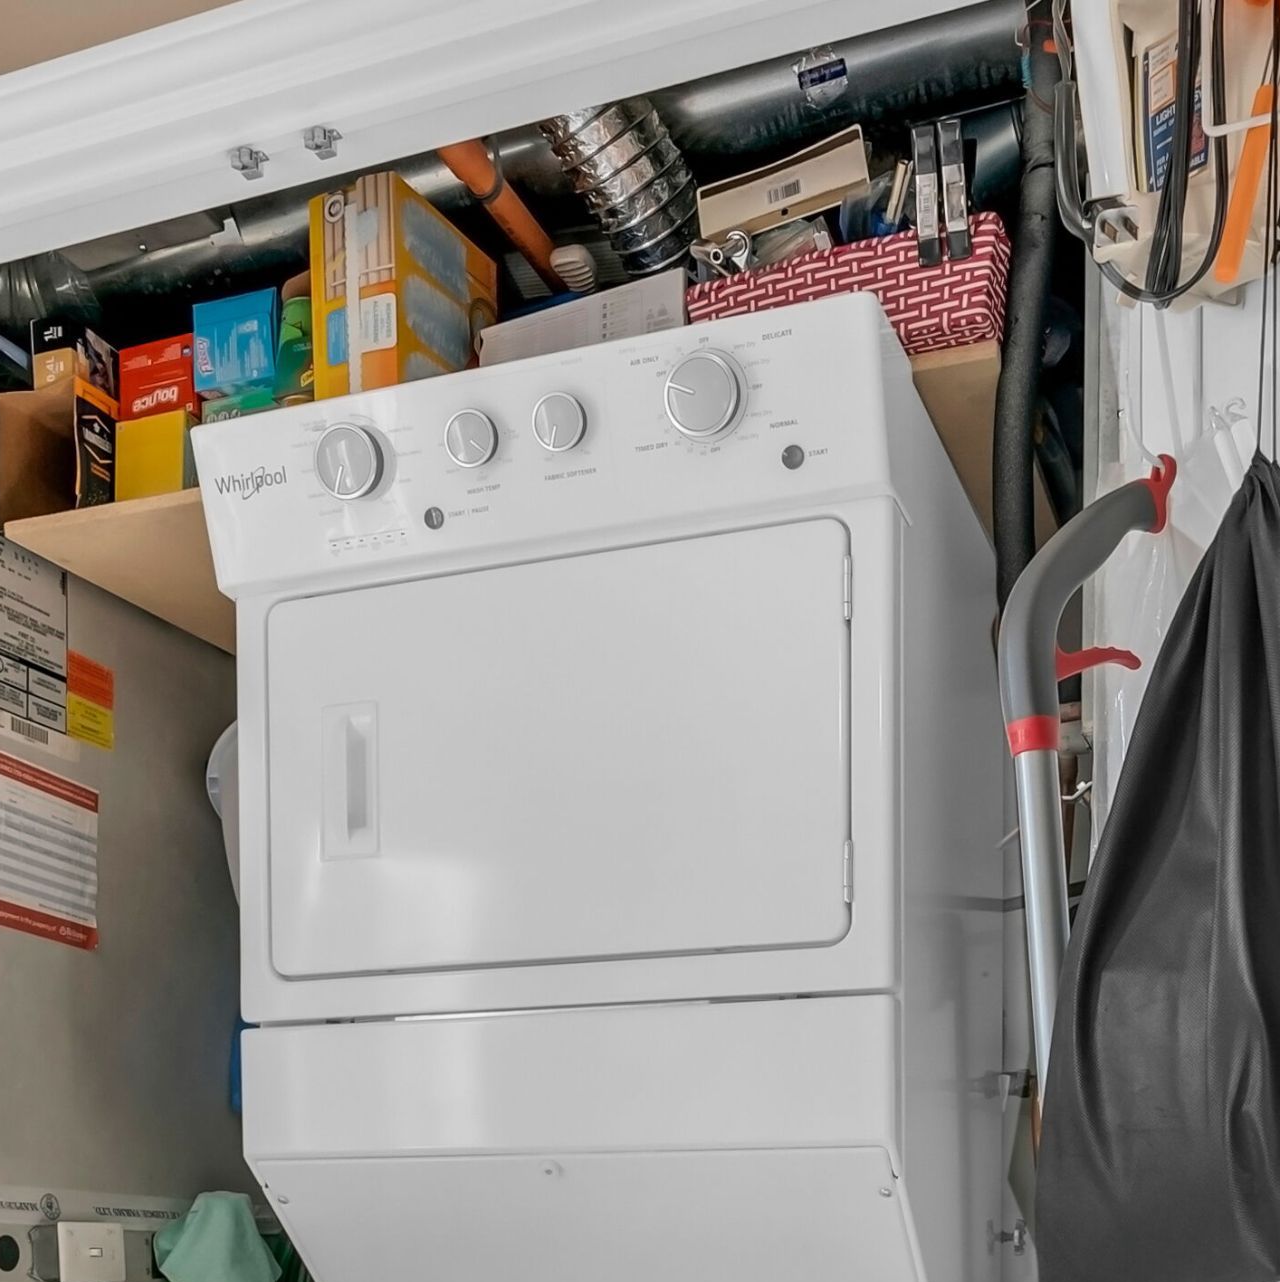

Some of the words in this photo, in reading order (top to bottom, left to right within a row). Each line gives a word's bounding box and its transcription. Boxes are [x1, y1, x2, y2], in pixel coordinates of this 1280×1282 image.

[762, 328, 793, 341] DELICATE
[630, 358, 641, 366] AIR
[643, 355, 659, 365] ONLY
[132, 385, 179, 412] bounce
[770, 418, 799, 429] NORMAL
[808, 448, 829, 457] START
[544, 472, 566, 481] FABRIC
[567, 468, 597, 479] SOFTENER
[214, 465, 288, 500] Whirlpool
[466, 486, 484, 495] WASH
[485, 484, 501, 493] TEMP
[448, 509, 466, 518] START
[472, 506, 490, 514] PAUSE
